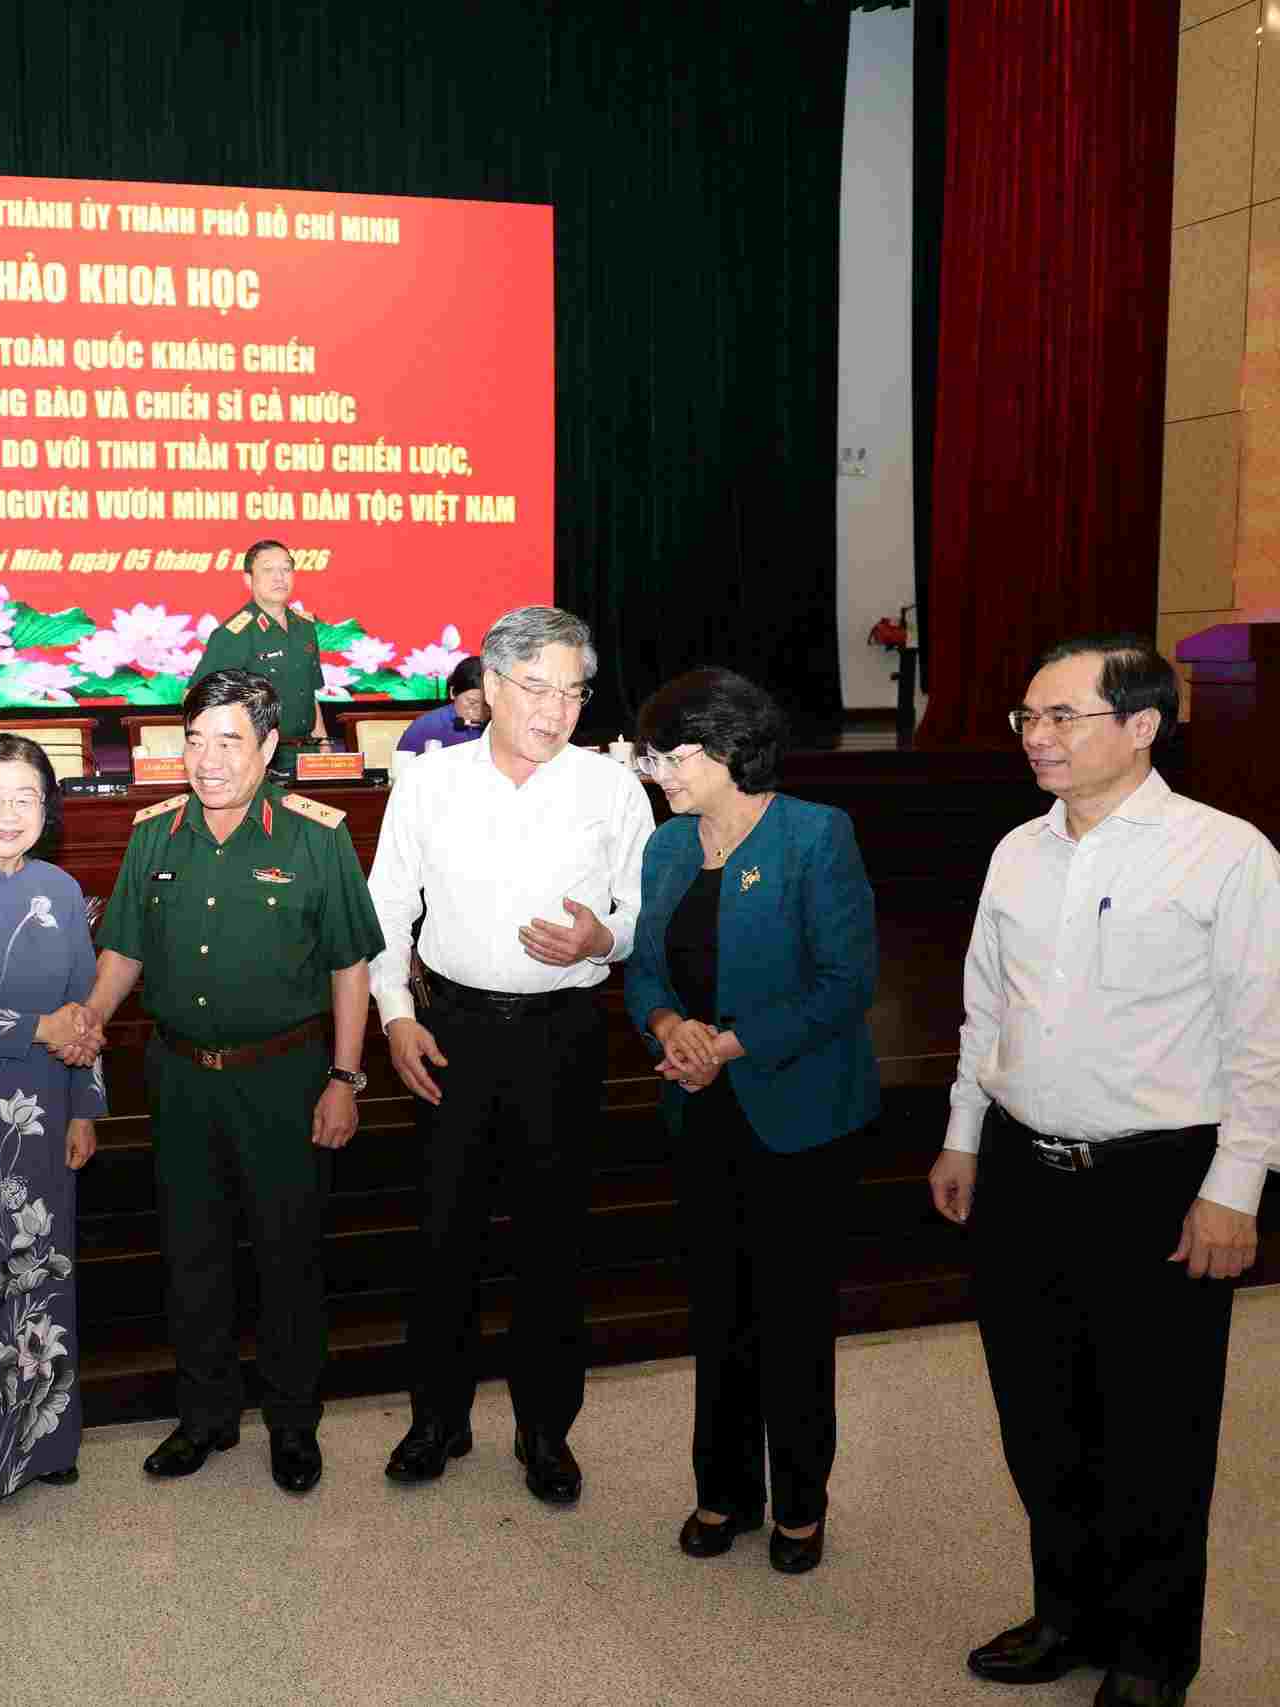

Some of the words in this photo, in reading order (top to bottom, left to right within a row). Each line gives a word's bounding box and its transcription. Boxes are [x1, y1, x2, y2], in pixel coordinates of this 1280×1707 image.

[80, 197, 112, 231] ỦY
[117, 201, 195, 235] THÀNH
[203, 202, 249, 236] PHỐ
[257, 203, 287, 238] HỒ
[295, 209, 335, 240] CHÍ
[341, 214, 400, 244] MINH
[80, 263, 176, 306] KHOA
[187, 267, 260, 316] HỌC
[74, 331, 144, 371] QUỐC
[151, 338, 235, 372] KHÁNG
[243, 336, 315, 374] CHIẾN
[35, 386, 87, 418] BÀO
[95, 385, 129, 418] VÀ
[136, 384, 210, 420] CHIẾN
[217, 389, 243, 421] SĨ
[250, 388, 283, 421] CẢ
[2, 439, 37, 468] DO
[45, 436, 89, 469] VỚI
[97, 441, 156, 469] TINH
[164, 433, 228, 470] THẦN
[236, 440, 270, 475] TỰ
[274, 437, 324, 471] CHỦ
[332, 436, 401, 473] CHIẾN
[172, 488, 238, 520] MÌNH
[246, 486, 295, 520] CỦA
[302, 489, 350, 521] DÂN
[357, 490, 402, 525] TỘC
[410, 491, 458, 526] VIỆT
[465, 496, 515, 523] NAM
